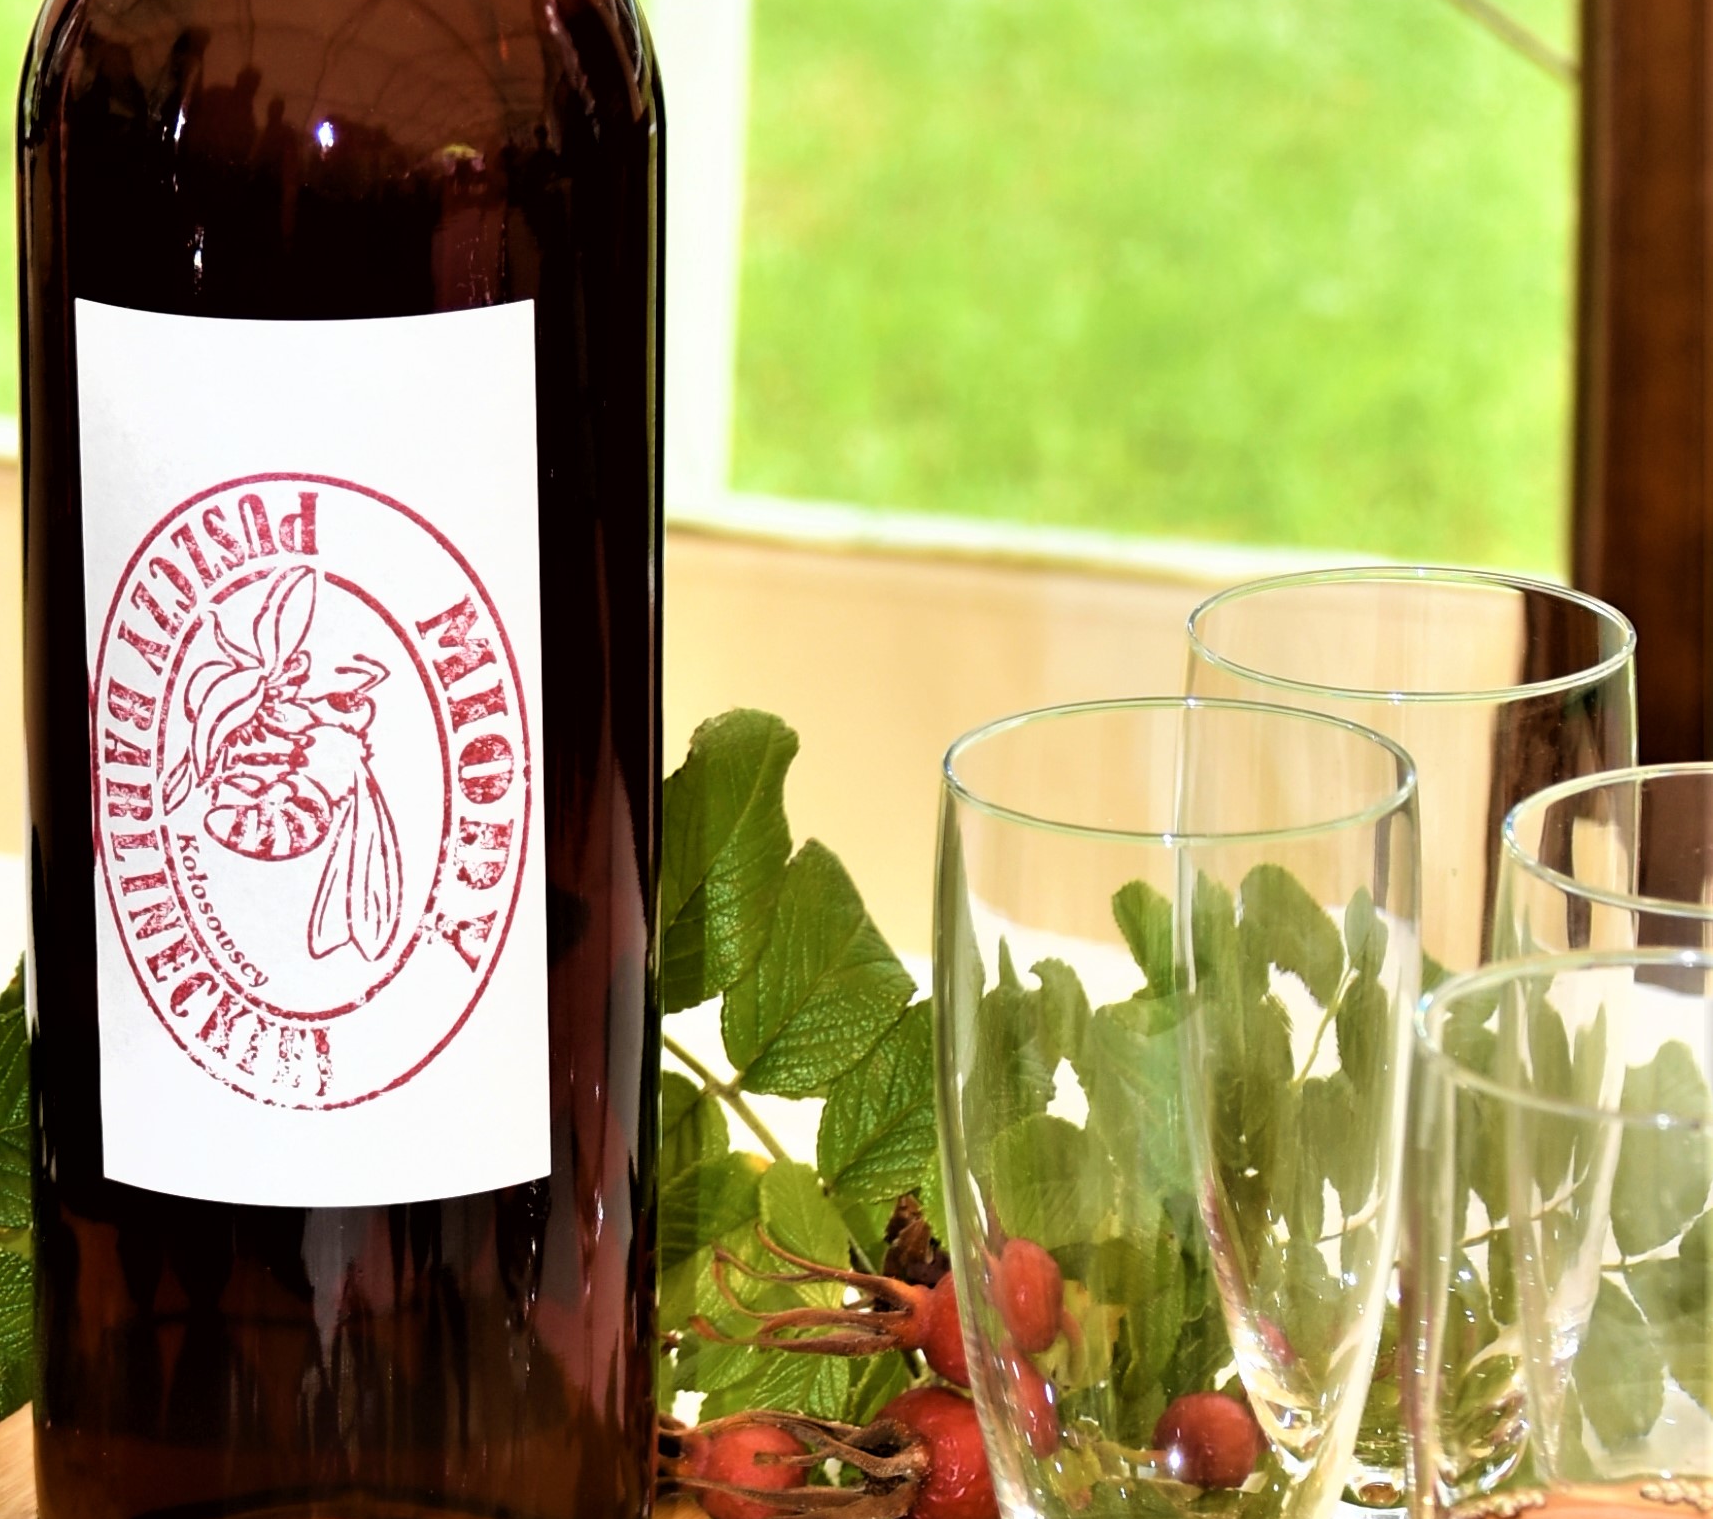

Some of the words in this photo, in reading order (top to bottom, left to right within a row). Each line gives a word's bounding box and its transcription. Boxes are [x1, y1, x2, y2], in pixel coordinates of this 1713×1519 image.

[117, 492, 319, 675] PUSZCZY
[103, 675, 333, 1098] BARLINECKIEJ
[176, 833, 269, 988] Kołosowscy
[416, 595, 515, 972] MIODY
